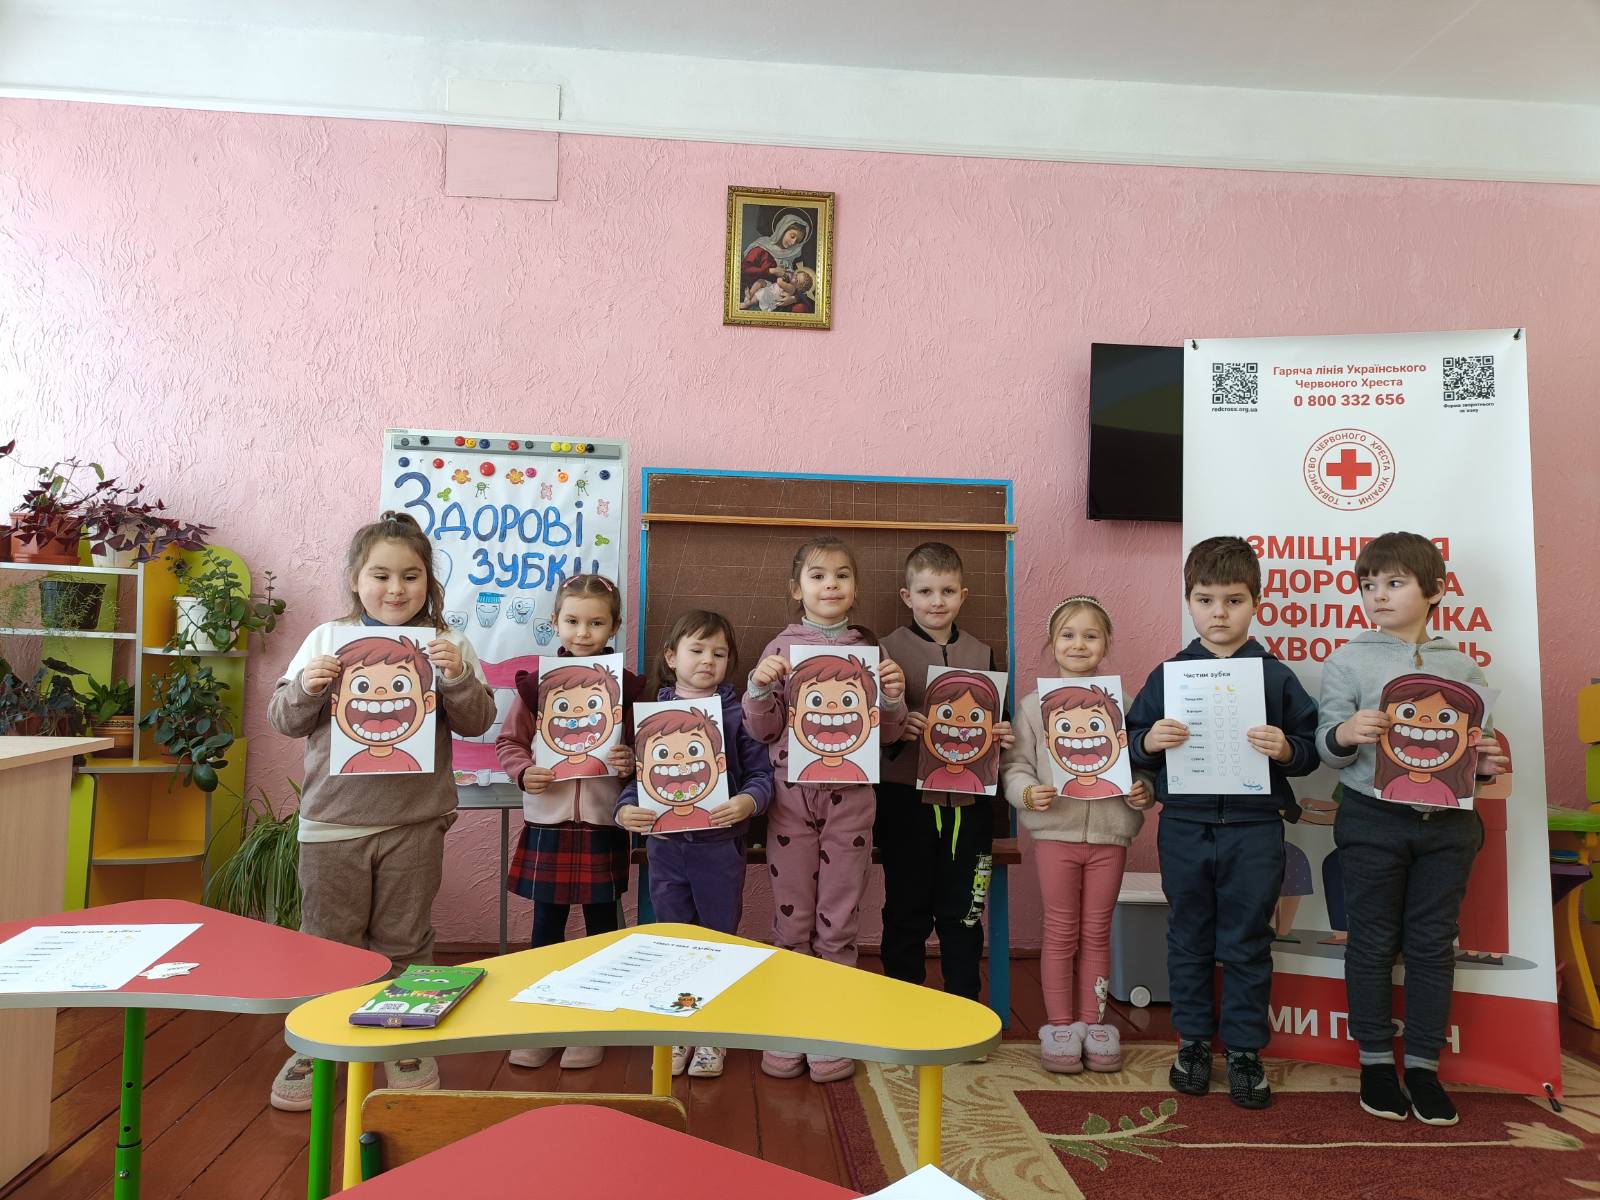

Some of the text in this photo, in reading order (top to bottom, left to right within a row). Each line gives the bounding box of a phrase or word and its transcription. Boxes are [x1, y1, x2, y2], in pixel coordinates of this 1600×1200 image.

[1273, 363, 1426, 378] Гаряча лінія Українського
[1295, 378, 1403, 391] Червоного Хреста
[1293, 393, 1405, 406] 0 800 332 656
[1315, 432, 1367, 452] ЧЕРВОНОГО
[1370, 440, 1391, 471] ХРЕСТА
[1308, 457, 1339, 505] ТОВАРИСТВО
[1246, 535, 1450, 566] ЗМІЦНЯ
